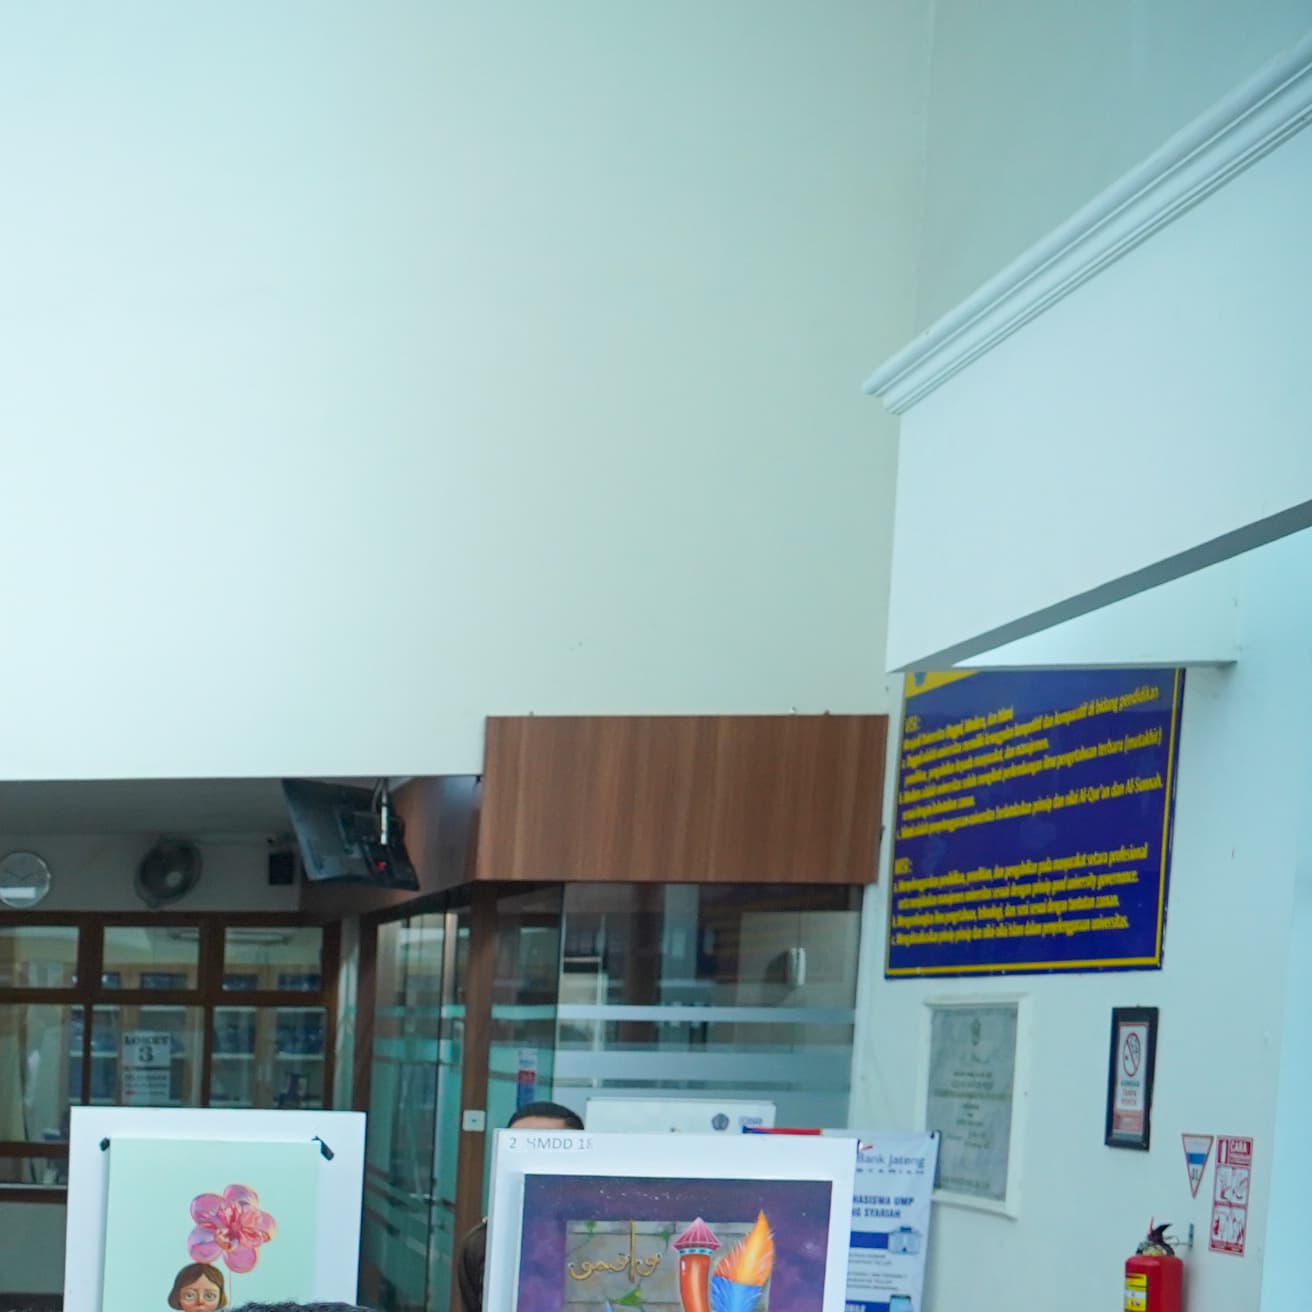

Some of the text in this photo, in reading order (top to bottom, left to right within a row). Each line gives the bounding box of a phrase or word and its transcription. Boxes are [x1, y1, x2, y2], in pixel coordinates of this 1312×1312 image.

[139, 1046, 154, 1062] 3
[509, 1137, 517, 1149] 2
[893, 1196, 914, 1206] UMP
